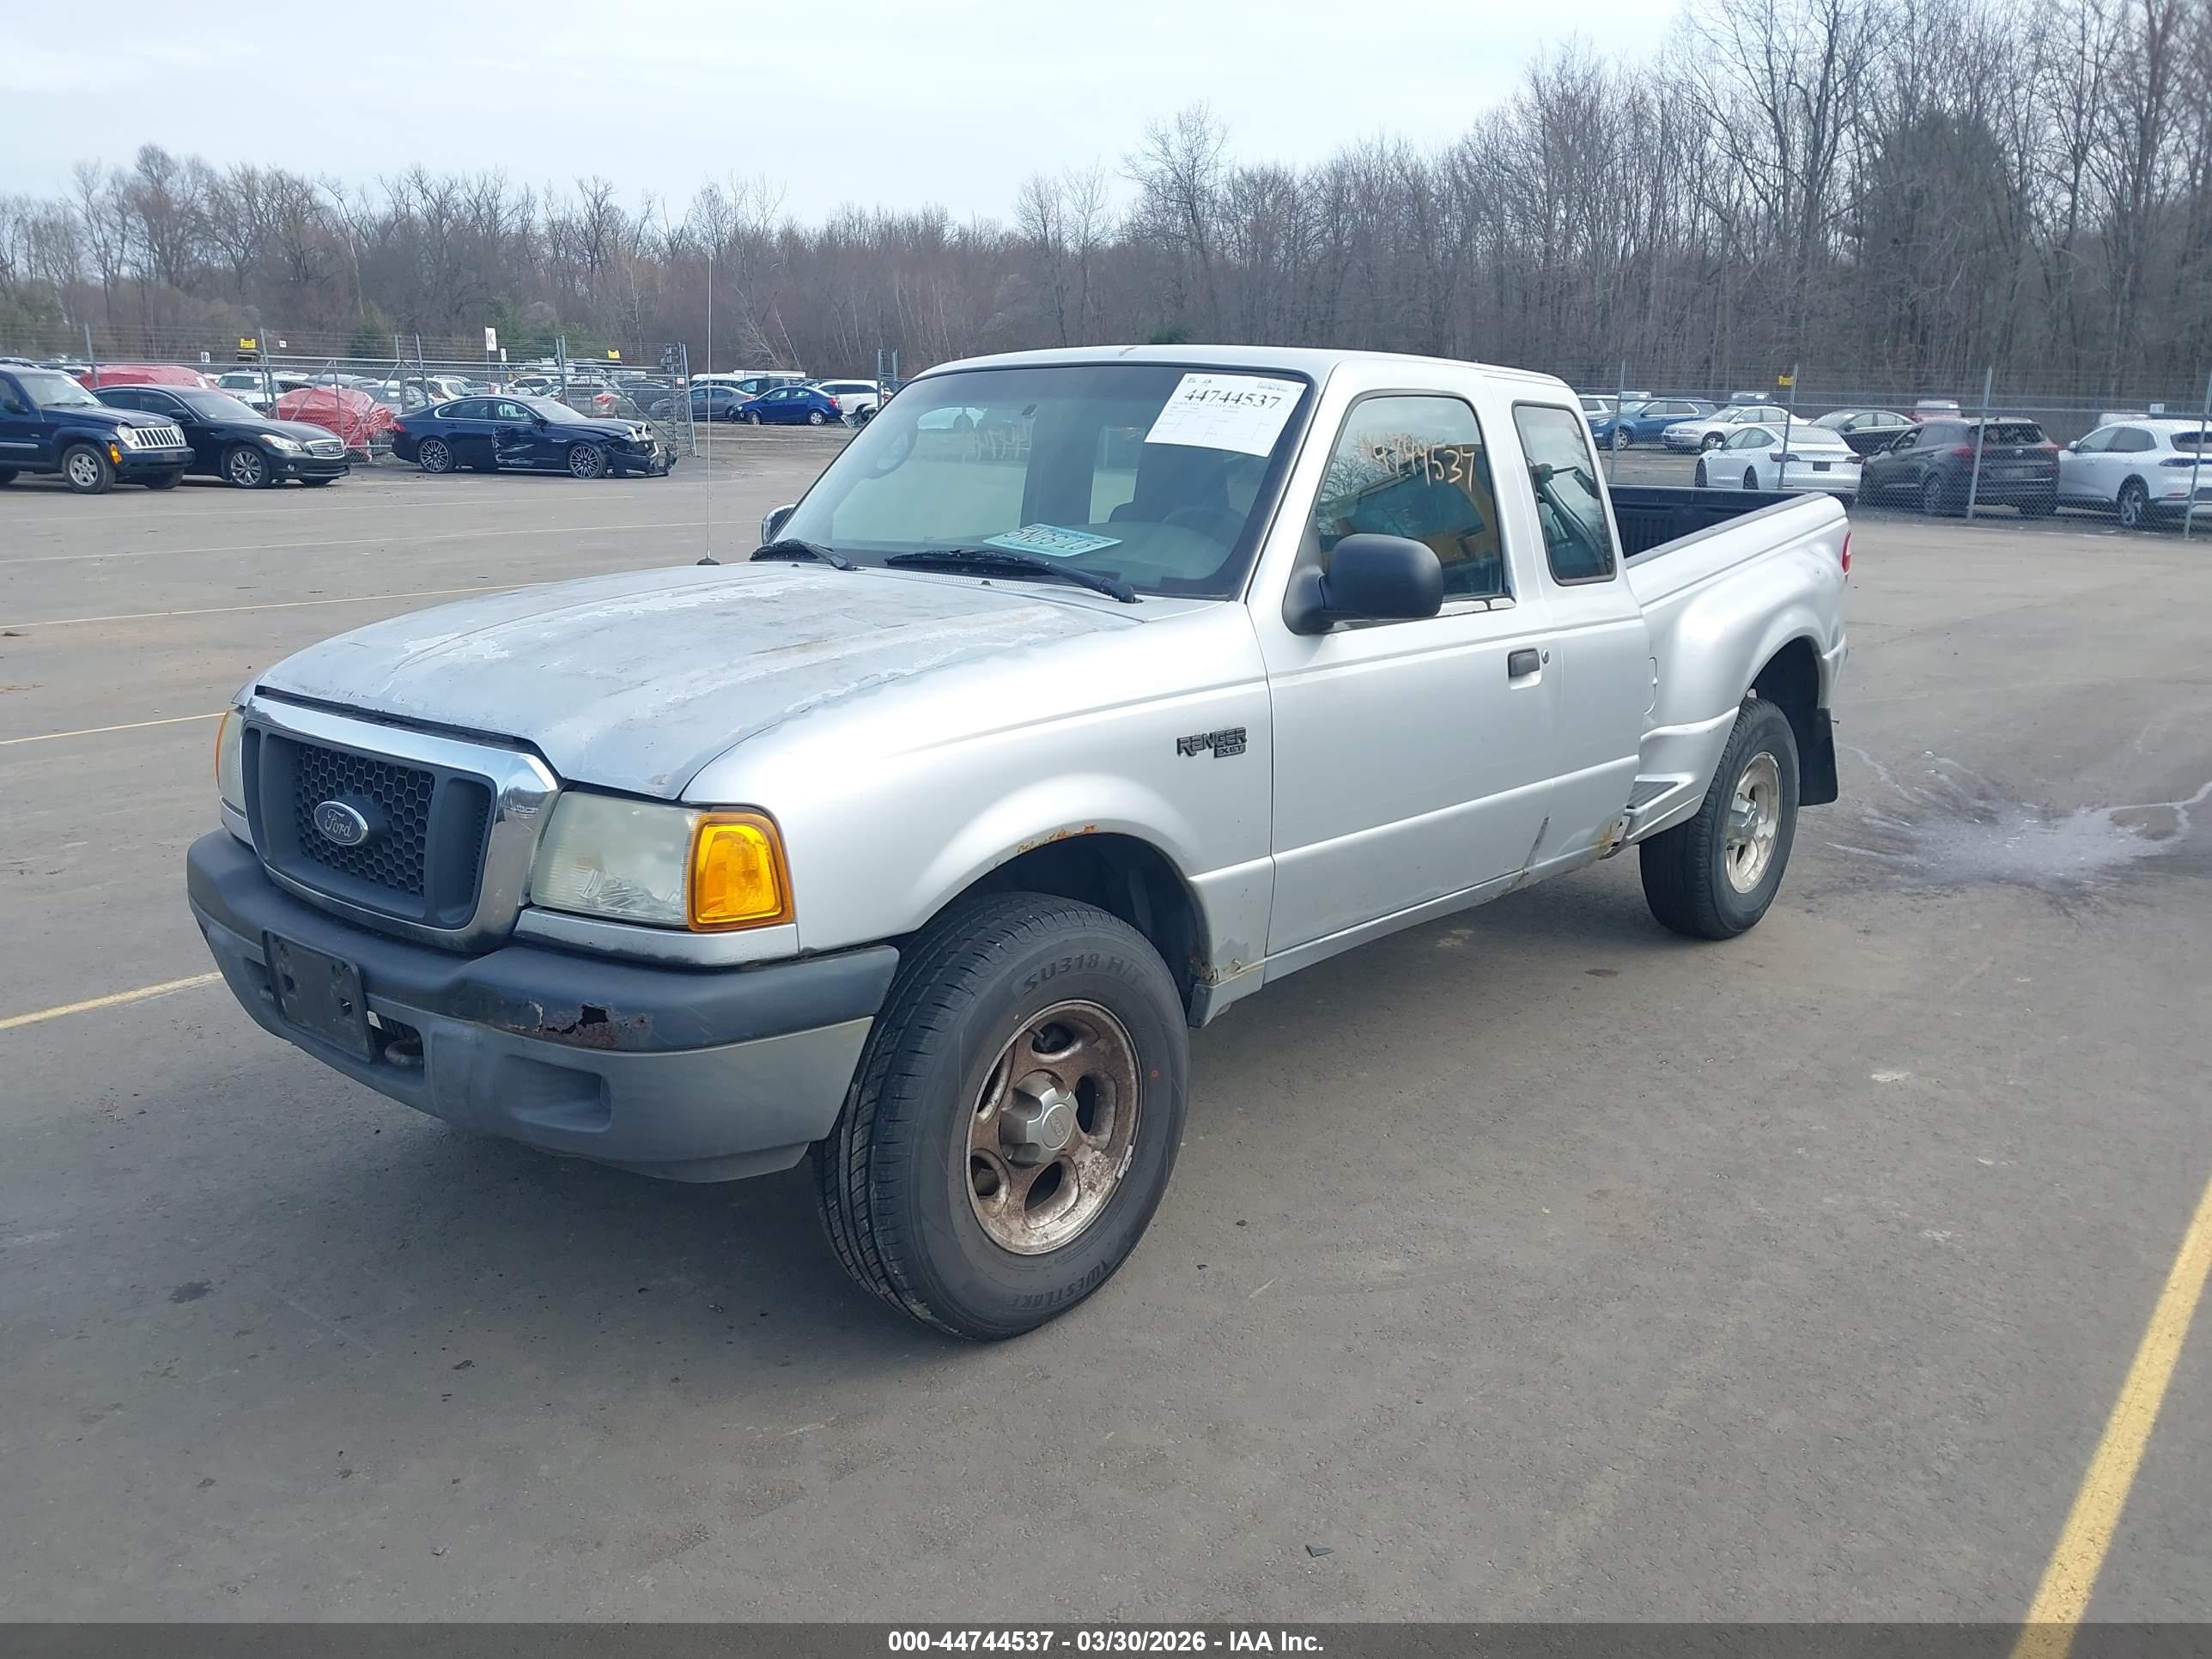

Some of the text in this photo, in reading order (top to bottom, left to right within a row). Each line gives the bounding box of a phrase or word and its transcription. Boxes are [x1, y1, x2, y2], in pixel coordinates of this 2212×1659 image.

[1184, 389, 1282, 410] 44744537
[1176, 726, 1248, 757] RANGER
[325, 809, 352, 837] Ford
[1023, 953, 1100, 996] SU318
